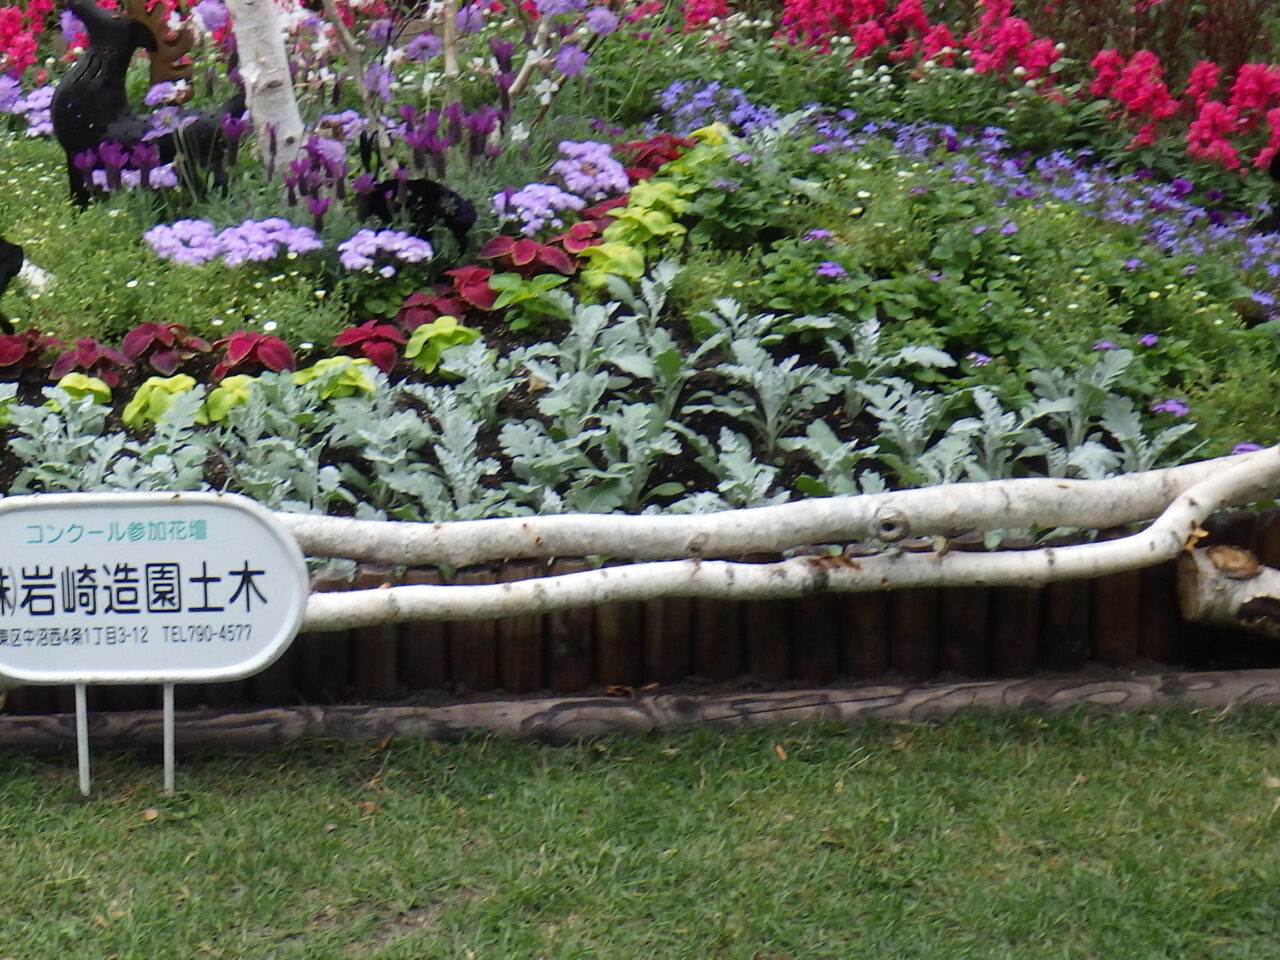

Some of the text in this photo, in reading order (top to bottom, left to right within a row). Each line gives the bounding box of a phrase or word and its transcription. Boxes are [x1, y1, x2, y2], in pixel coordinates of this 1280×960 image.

[25, 519, 208, 545] コンクール参加花壇
